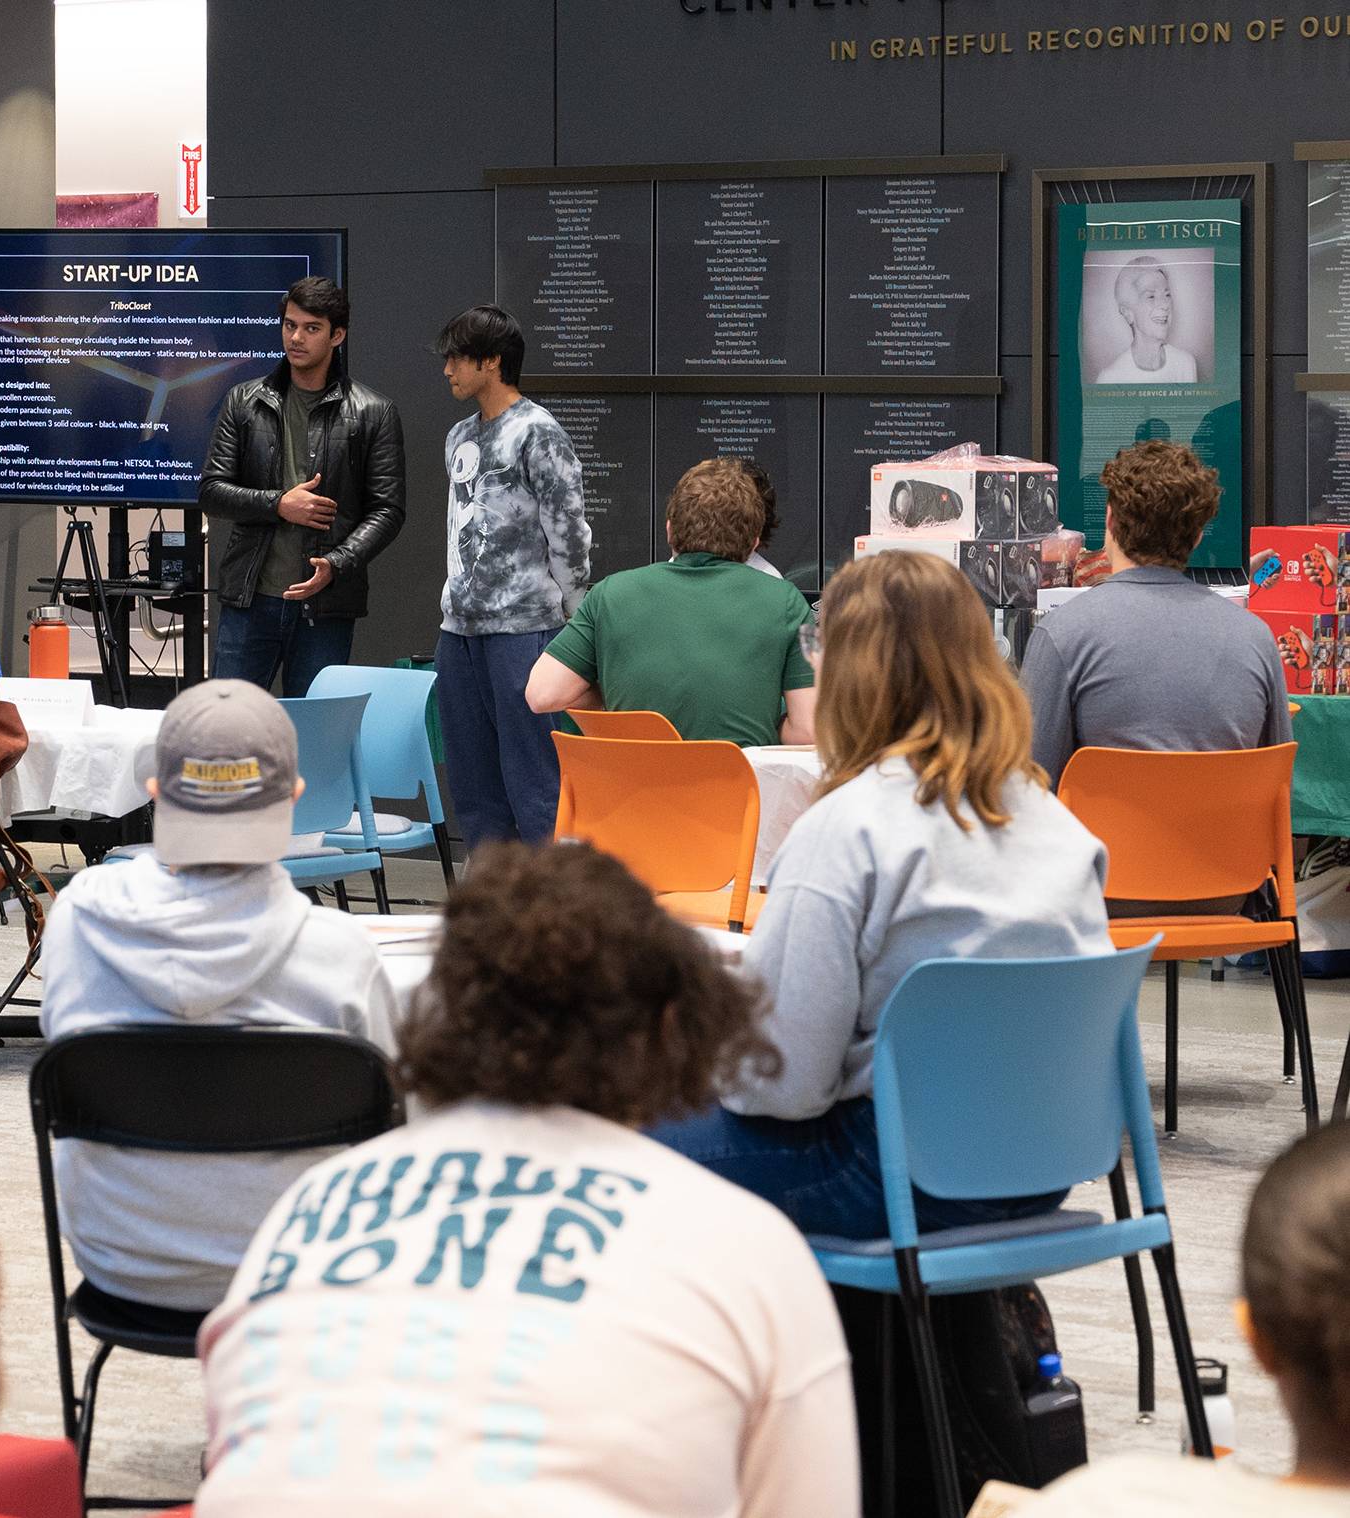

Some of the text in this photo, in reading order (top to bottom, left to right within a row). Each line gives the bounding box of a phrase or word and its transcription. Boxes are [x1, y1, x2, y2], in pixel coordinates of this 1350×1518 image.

[830, 40, 857, 60] IN
[869, 33, 1013, 59] GRATEFUL
[1028, 22, 1231, 52] RECOGNITION
[1246, 18, 1285, 42] OF
[184, 151, 201, 160] FIRE
[1077, 223, 1223, 241] BILLIE TISCH
[63, 265, 199, 282] START-UP IDEA
[110, 301, 151, 310] TriboCloset
[55, 315, 79, 324] altering
[81, 315, 91, 323] the
[93, 315, 122, 324] dynamics
[198, 316, 222, 324] fashion
[223, 316, 235, 324] and
[237, 316, 280, 326] technological
[0, 335, 13, 343] that
[14, 335, 41, 343] harvests
[84, 336, 117, 345] circulating
[118, 336, 137, 344] inside
[139, 336, 150, 344] the
[5, 348, 15, 356] the
[16, 348, 51, 358] technology
[101, 349, 151, 359] nanogenerators
[199, 350, 207, 358] to
[208, 350, 217, 358] be
[5, 381, 34, 390] designed
[20, 406, 51, 415] parachute
[0, 419, 18, 428] given
[19, 419, 47, 427] between
[70, 420, 94, 428] colours
[140, 421, 152, 429] and
[11, 457, 26, 465] with
[56, 458, 101, 467] developments
[0, 469, 7, 477] of
[9, 469, 19, 477] the
[20, 470, 45, 479] product
[47, 470, 54, 478] to
[55, 470, 63, 478] be
[81, 471, 96, 479] with
[97, 471, 136, 479] transmitters
[137, 472, 158, 480] where
[159, 472, 170, 480] the
[171, 473, 192, 481] device
[16, 482, 26, 490] for
[27, 482, 53, 490] wireless
[54, 483, 81, 492] charging
[83, 483, 90, 491] to
[276, 1151, 649, 1243] WHALE
[248, 1207, 606, 1303] BONE
